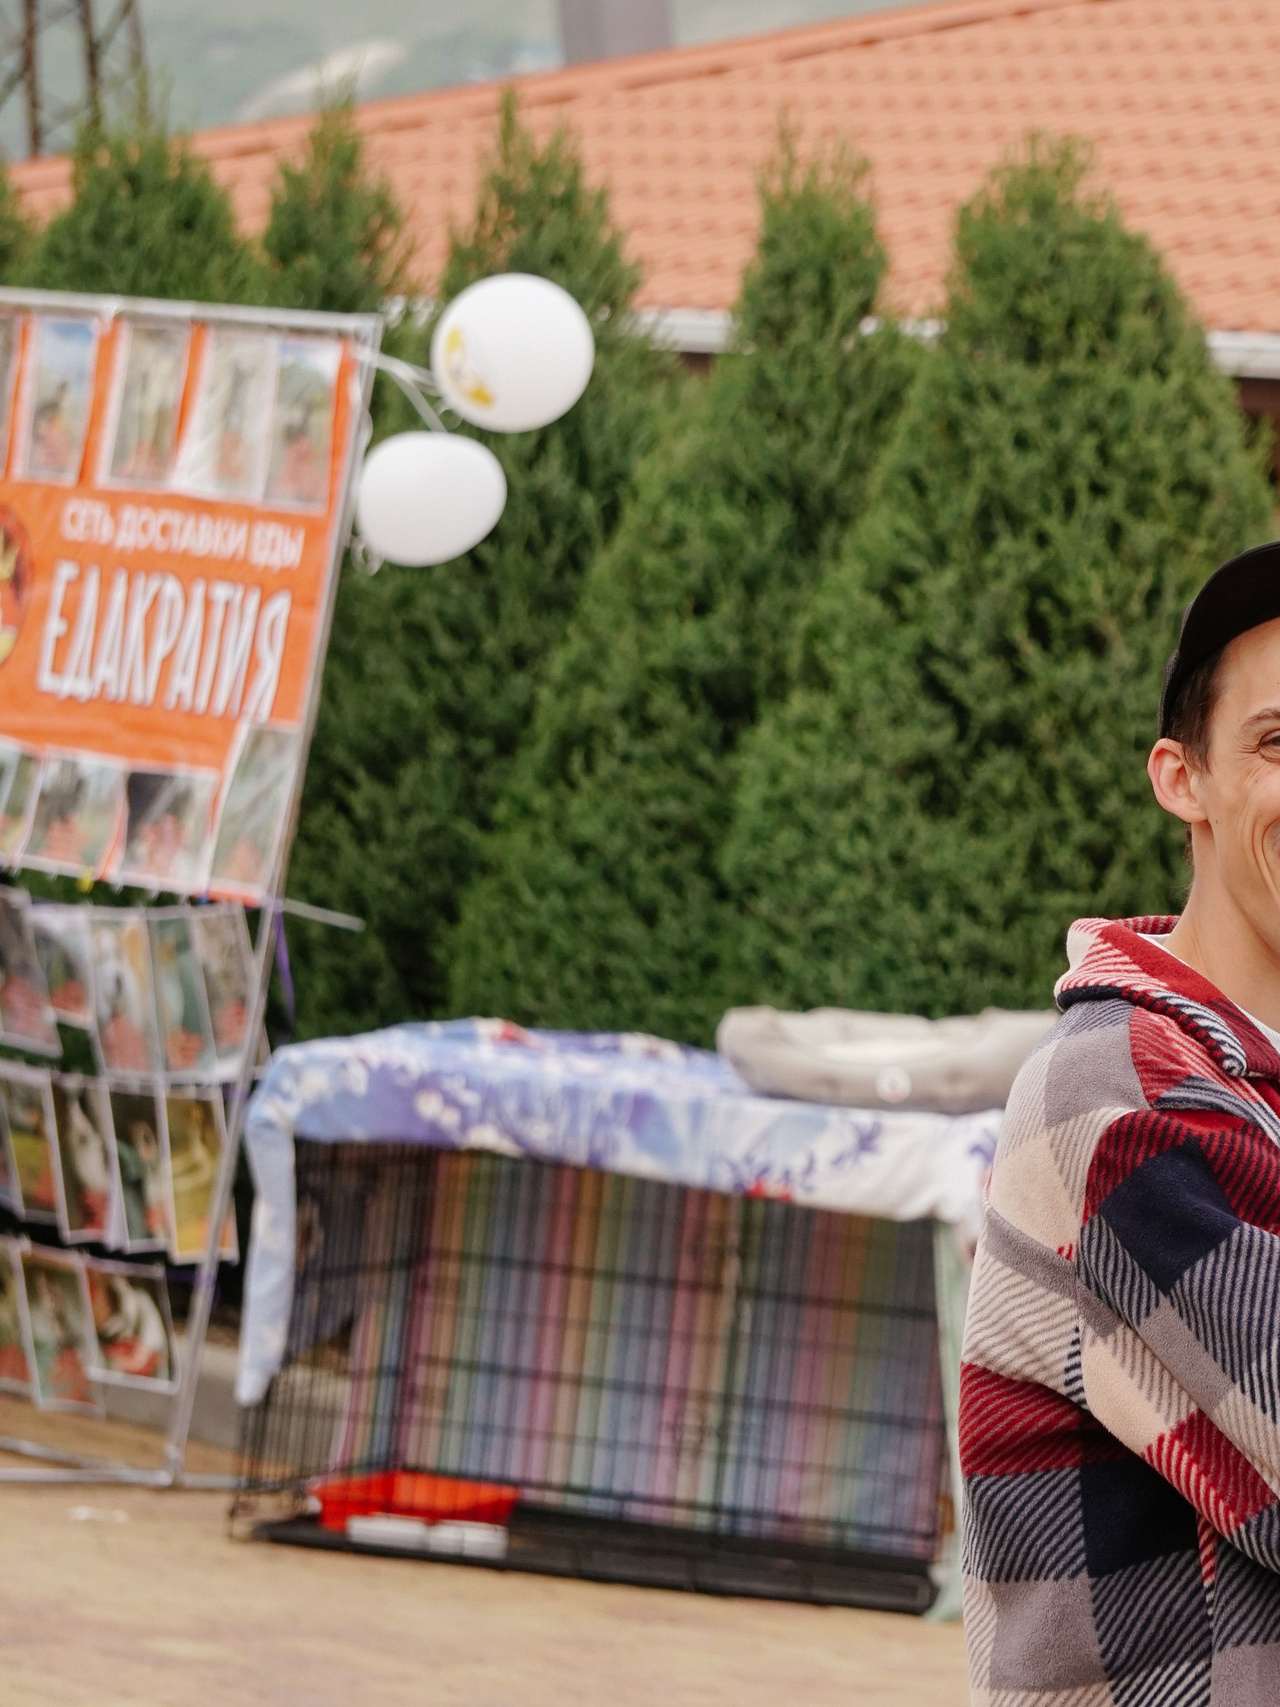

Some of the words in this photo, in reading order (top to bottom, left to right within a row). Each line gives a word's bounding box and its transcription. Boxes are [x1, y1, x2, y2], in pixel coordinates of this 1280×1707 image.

[60, 497, 115, 546] СЕТЬ
[112, 503, 249, 562] ДОСТАВКИ
[248, 520, 306, 573] ЕДЫ
[38, 559, 292, 725] ЕДАКРАТИЯ
